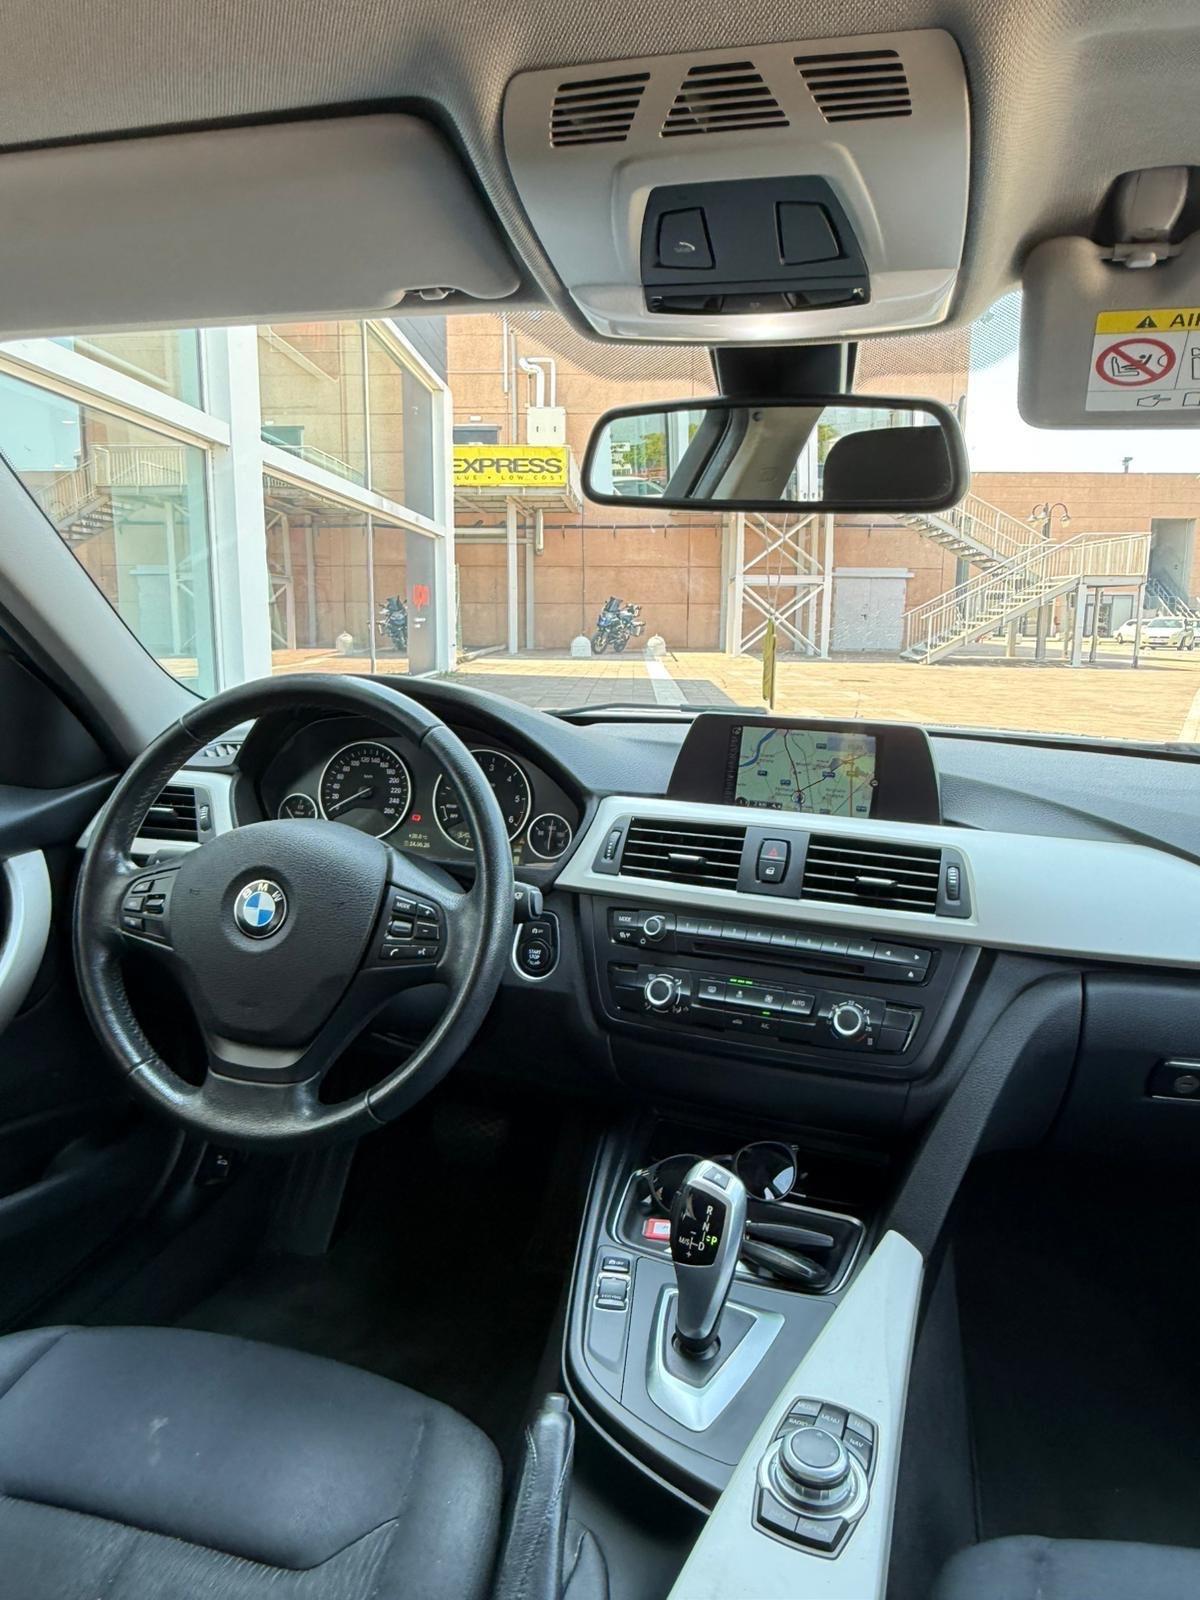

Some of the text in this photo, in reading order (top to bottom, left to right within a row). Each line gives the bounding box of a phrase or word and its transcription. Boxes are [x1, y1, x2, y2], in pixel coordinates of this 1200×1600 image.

[453, 457, 563, 474] EXPRESS
[706, 1205, 714, 1215] R
[702, 1222, 711, 1232] N
[697, 1241, 705, 1251] D
[710, 1236, 718, 1246] P
